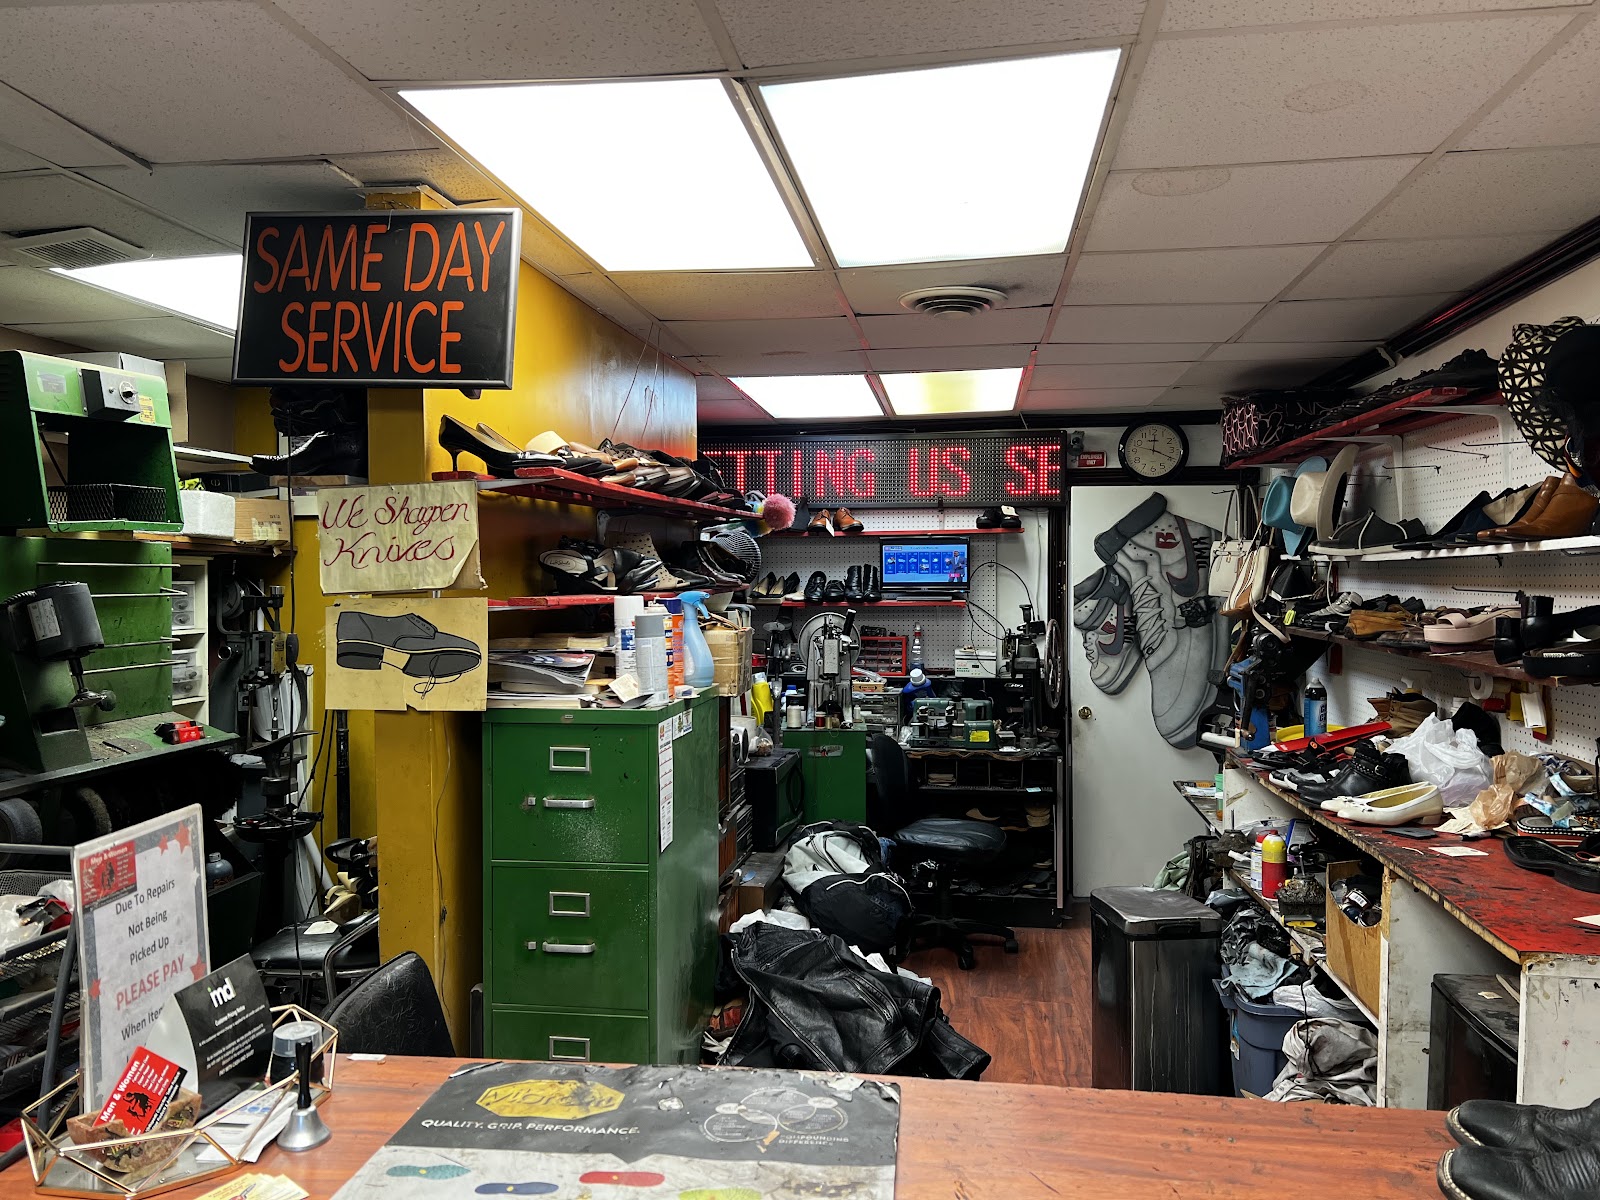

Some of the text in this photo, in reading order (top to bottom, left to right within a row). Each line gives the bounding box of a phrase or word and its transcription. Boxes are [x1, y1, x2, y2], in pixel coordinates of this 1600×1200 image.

[253, 221, 505, 293] SAME DAY
[279, 300, 464, 374] SERVICE
[910, 447, 970, 497] US
[374, 496, 469, 535] Sharpen
[324, 531, 455, 569] Knives
[115, 899, 132, 915] Due
[134, 893, 144, 906] To
[146, 879, 175, 900] Repairs
[128, 910, 168, 938] Not Being
[129, 936, 169, 965] Picked Up
[116, 953, 184, 1010] PLEASE PAY
[207, 977, 236, 1008] imd
[121, 1017, 147, 1040] When
[100, 1101, 117, 1122] Men
[112, 1093, 122, 1101] &
[117, 1061, 140, 1092] Women
[421, 1119, 641, 1135] QUALITY. GRIP. PERFORMANCE.
